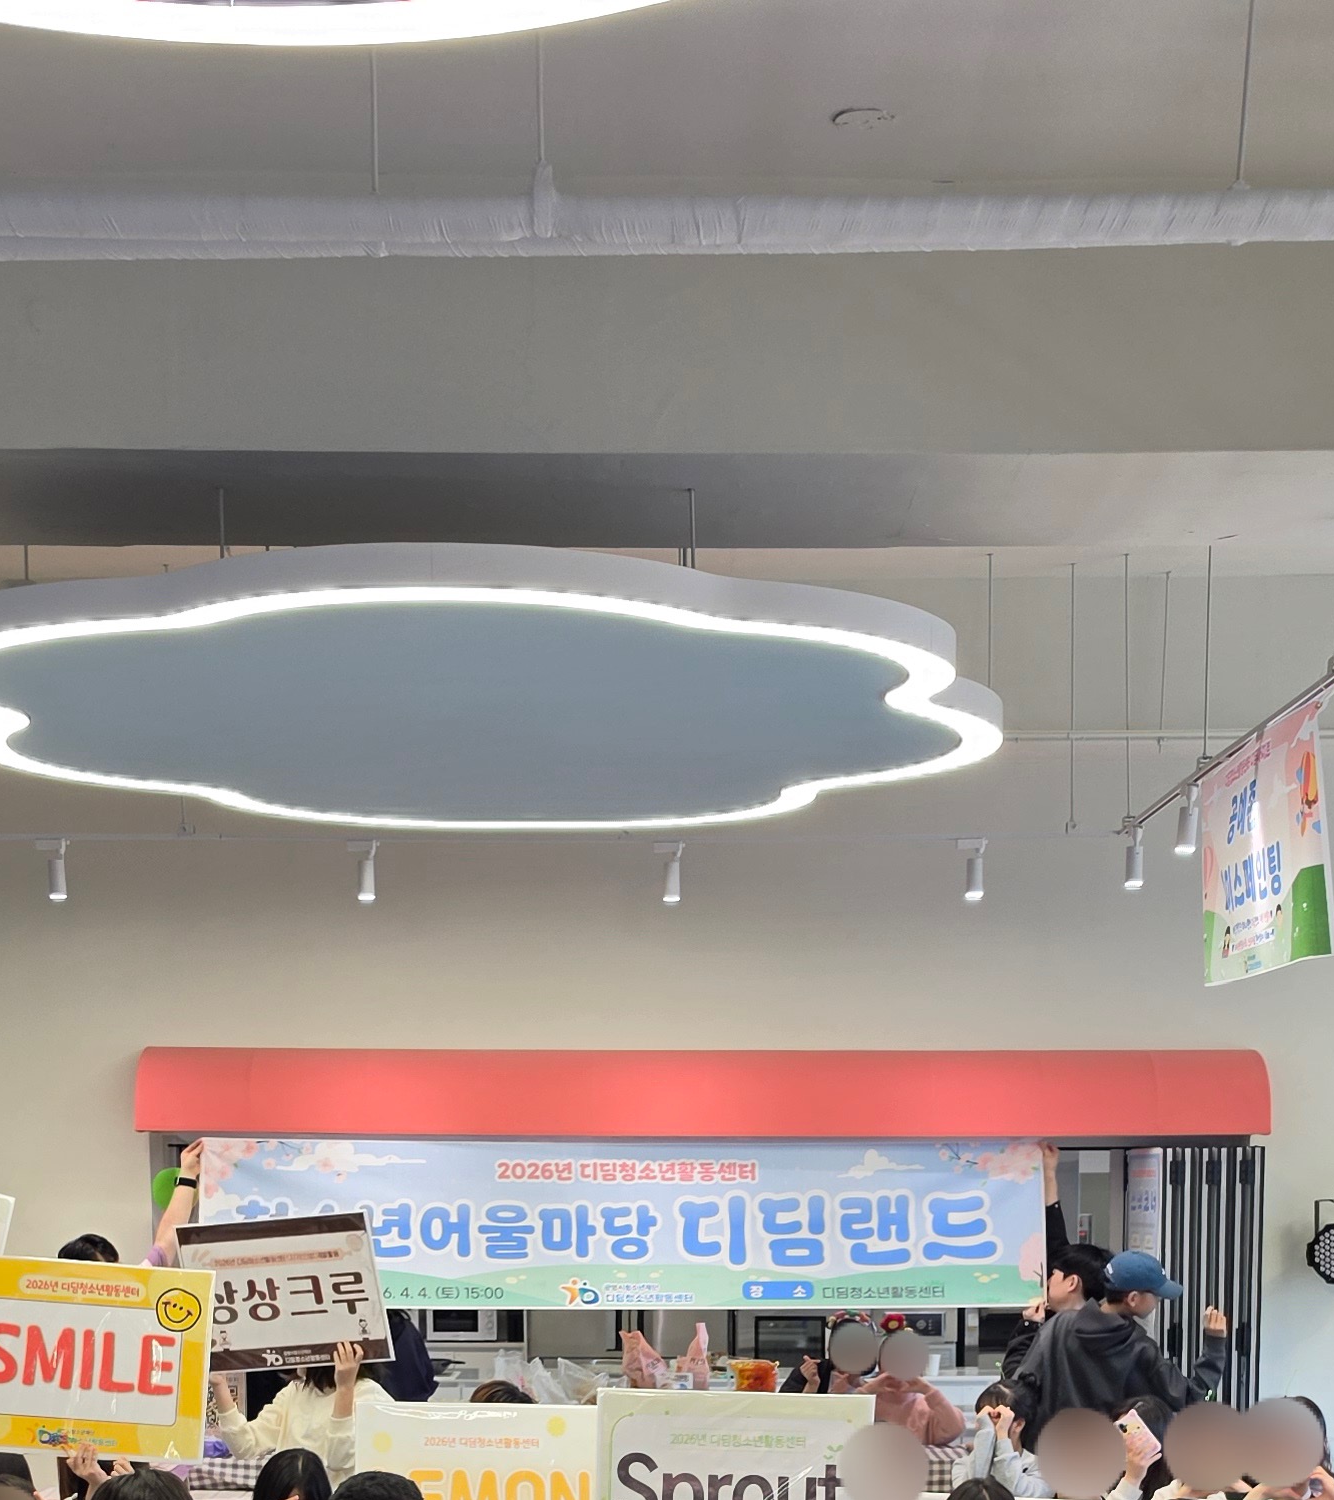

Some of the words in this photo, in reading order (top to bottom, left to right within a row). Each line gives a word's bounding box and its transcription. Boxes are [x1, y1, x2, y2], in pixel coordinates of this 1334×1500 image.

[496, 1161, 573, 1182] 2026년
[579, 1161, 757, 1182] 디딤청소년활동센터
[678, 1193, 998, 1268] 디딤랜드
[25, 1279, 59, 1293] 2026년
[61, 1281, 140, 1298] 디딤청소년활동센터
[400, 1286, 414, 1299] 4.
[417, 1286, 432, 1299] 4.
[435, 1286, 460, 1300] (토)
[464, 1286, 505, 1300] 15:00
[821, 1286, 946, 1300] 디딤청소년활동센터
[213, 1271, 370, 1325] 상상크루
[424, 1436, 456, 1448] 2026년
[459, 1436, 540, 1449] 디딤청소년활동센터
[669, 1433, 707, 1447] 2026년
[710, 1434, 807, 1449] 디딤청소년활동센터
